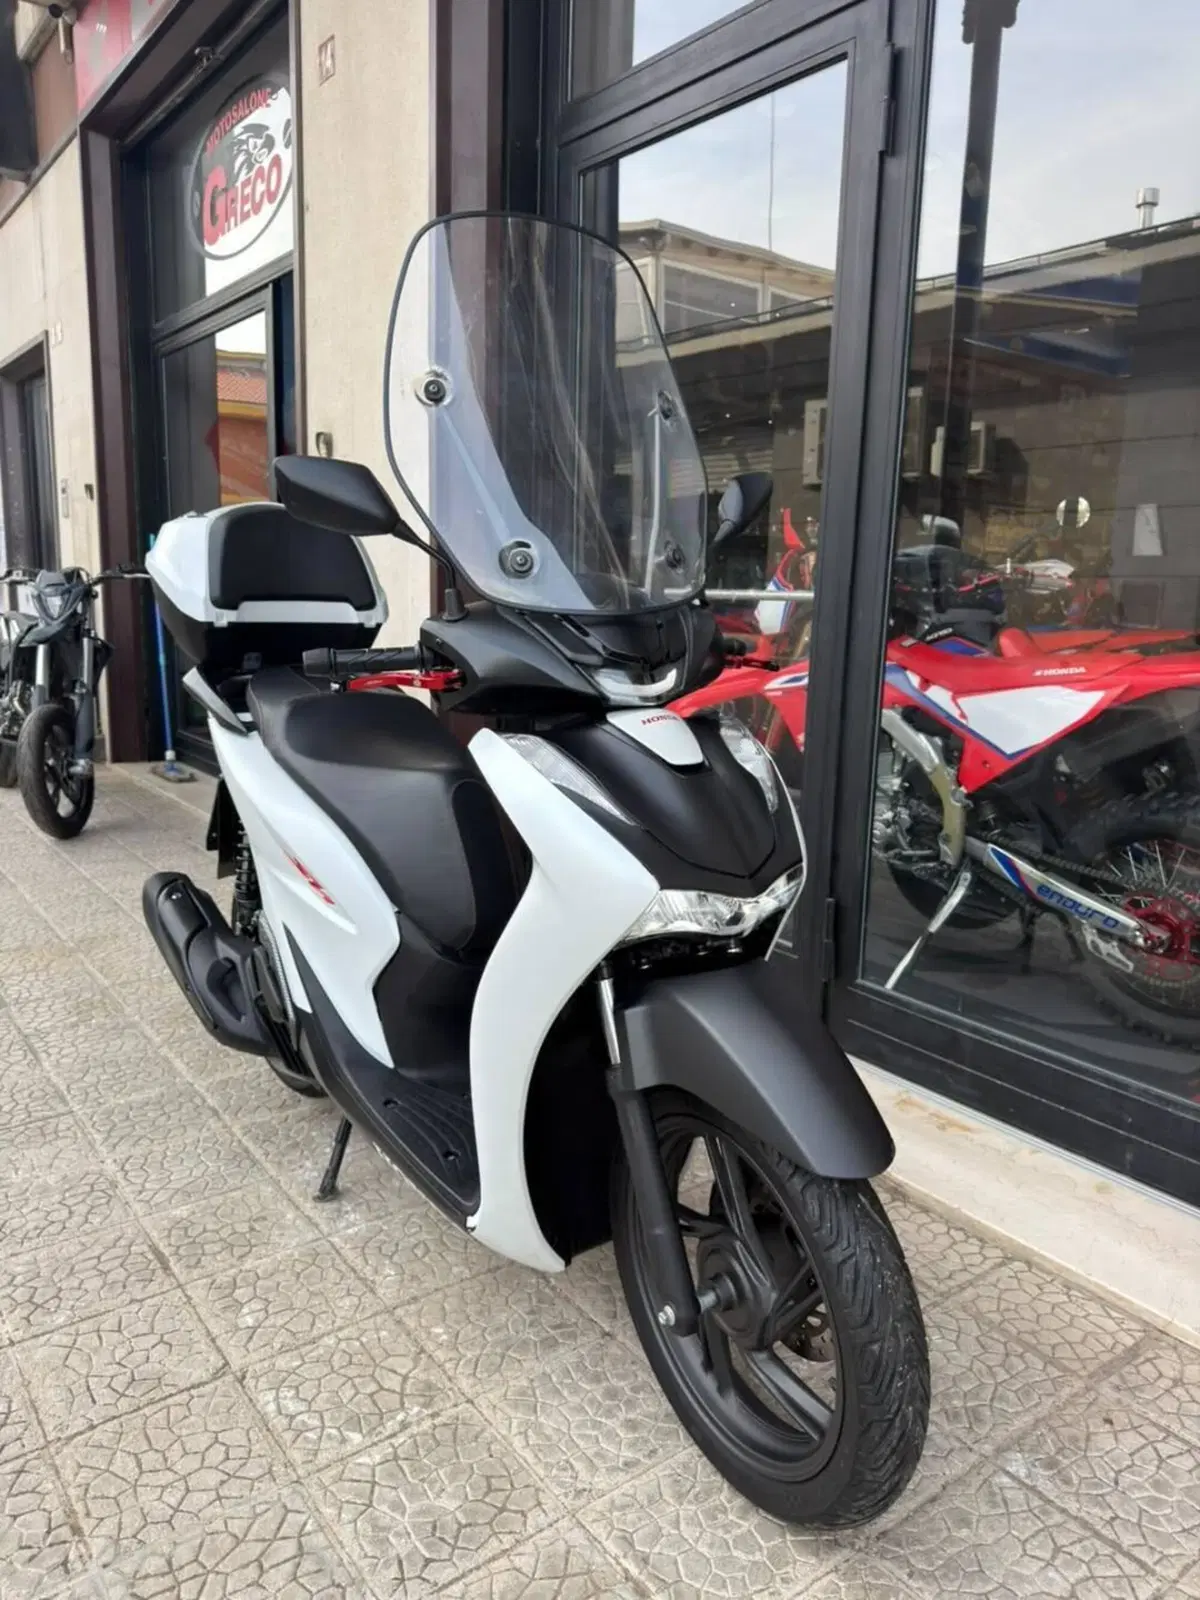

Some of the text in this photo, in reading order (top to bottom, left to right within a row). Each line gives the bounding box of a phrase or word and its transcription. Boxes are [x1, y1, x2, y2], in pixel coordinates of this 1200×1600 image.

[205, 87, 272, 159] MOTOSALONE
[203, 153, 282, 246] GRECO
[1043, 666, 1087, 677] HONDA
[1037, 884, 1119, 929] enduro
